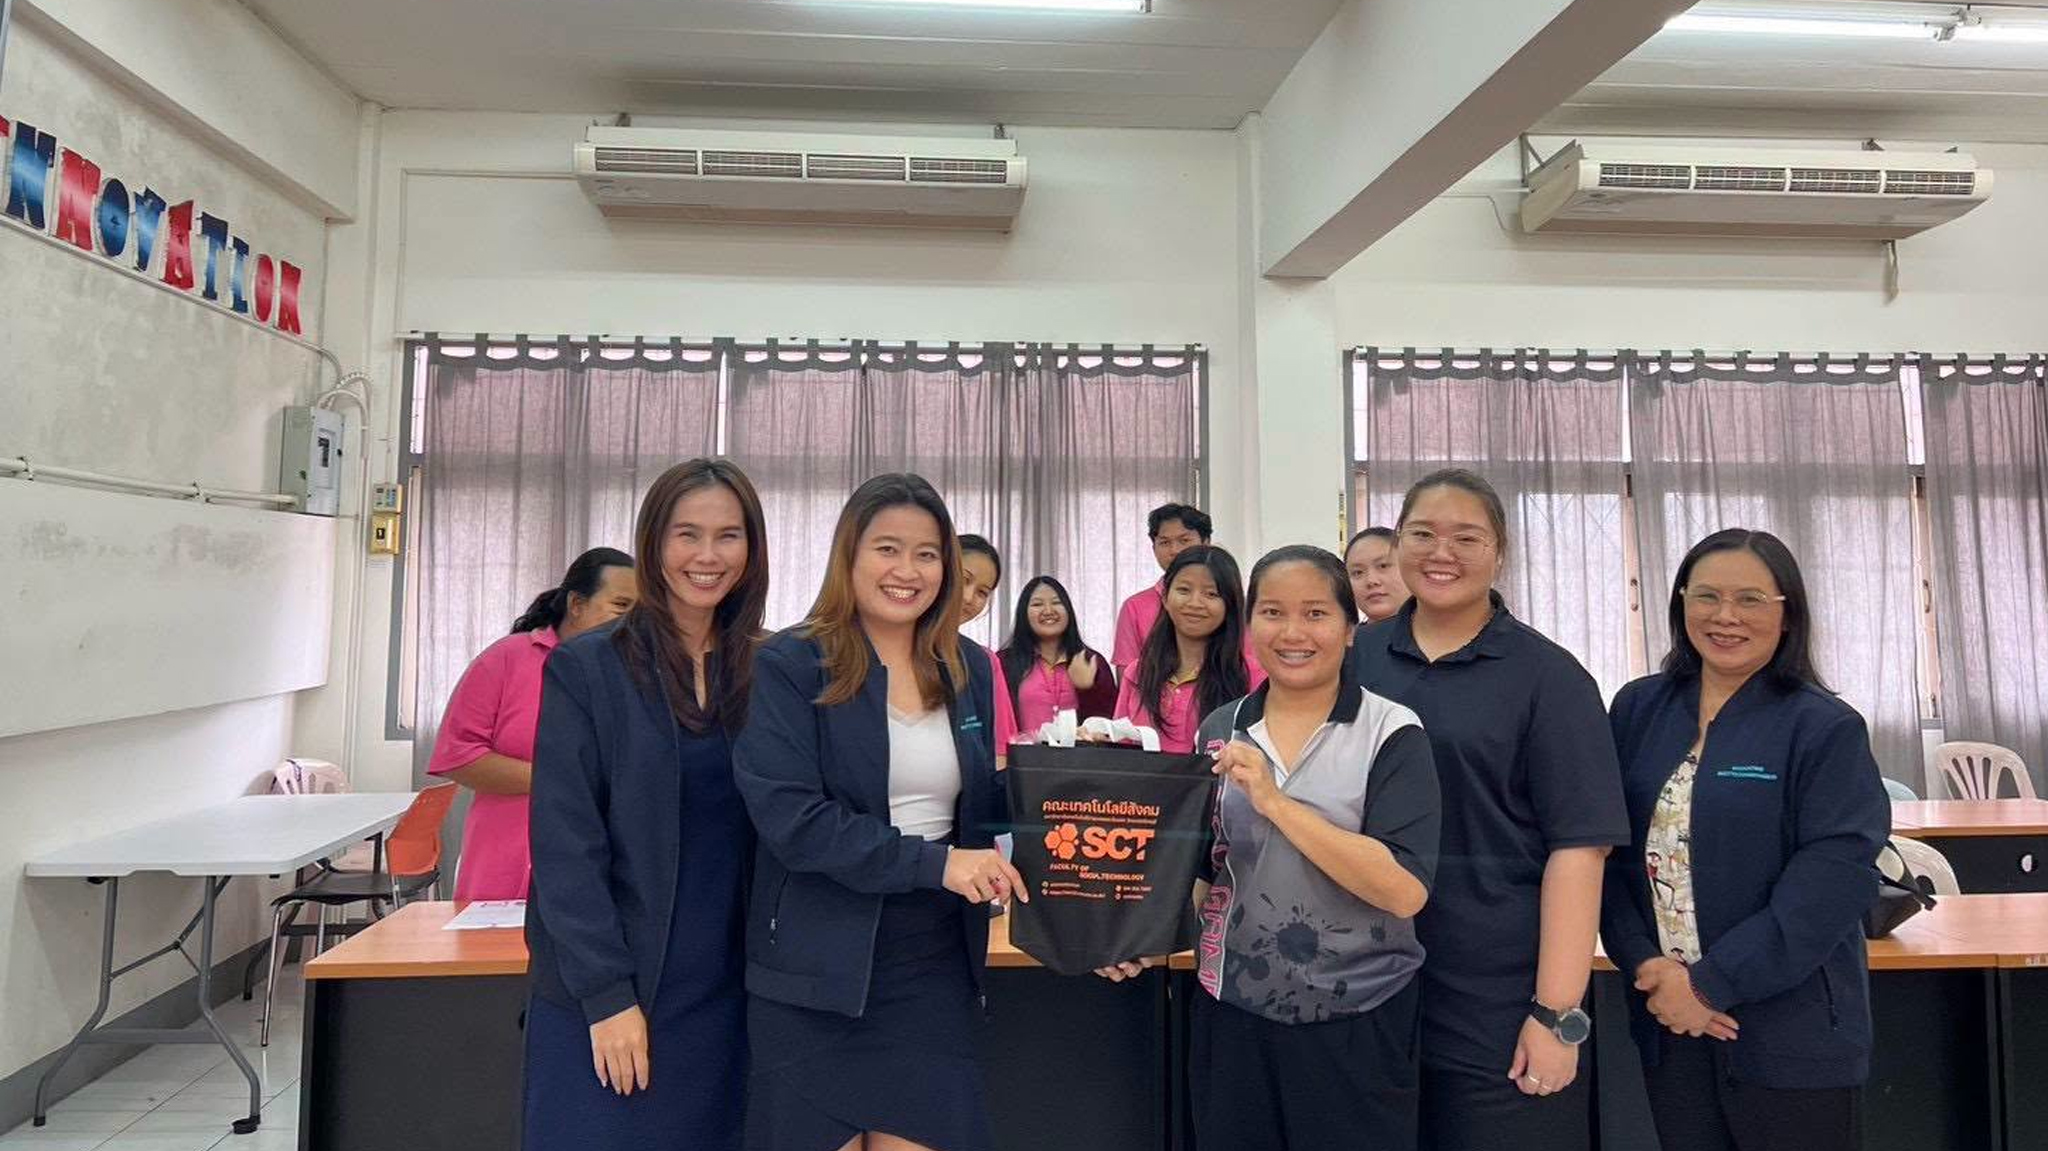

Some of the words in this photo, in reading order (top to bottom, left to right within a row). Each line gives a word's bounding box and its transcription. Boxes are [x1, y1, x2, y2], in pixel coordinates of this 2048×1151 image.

[1042, 799, 1160, 816] คณะเทคโนโลยีสังคม
[1081, 826, 1155, 860] SCT
